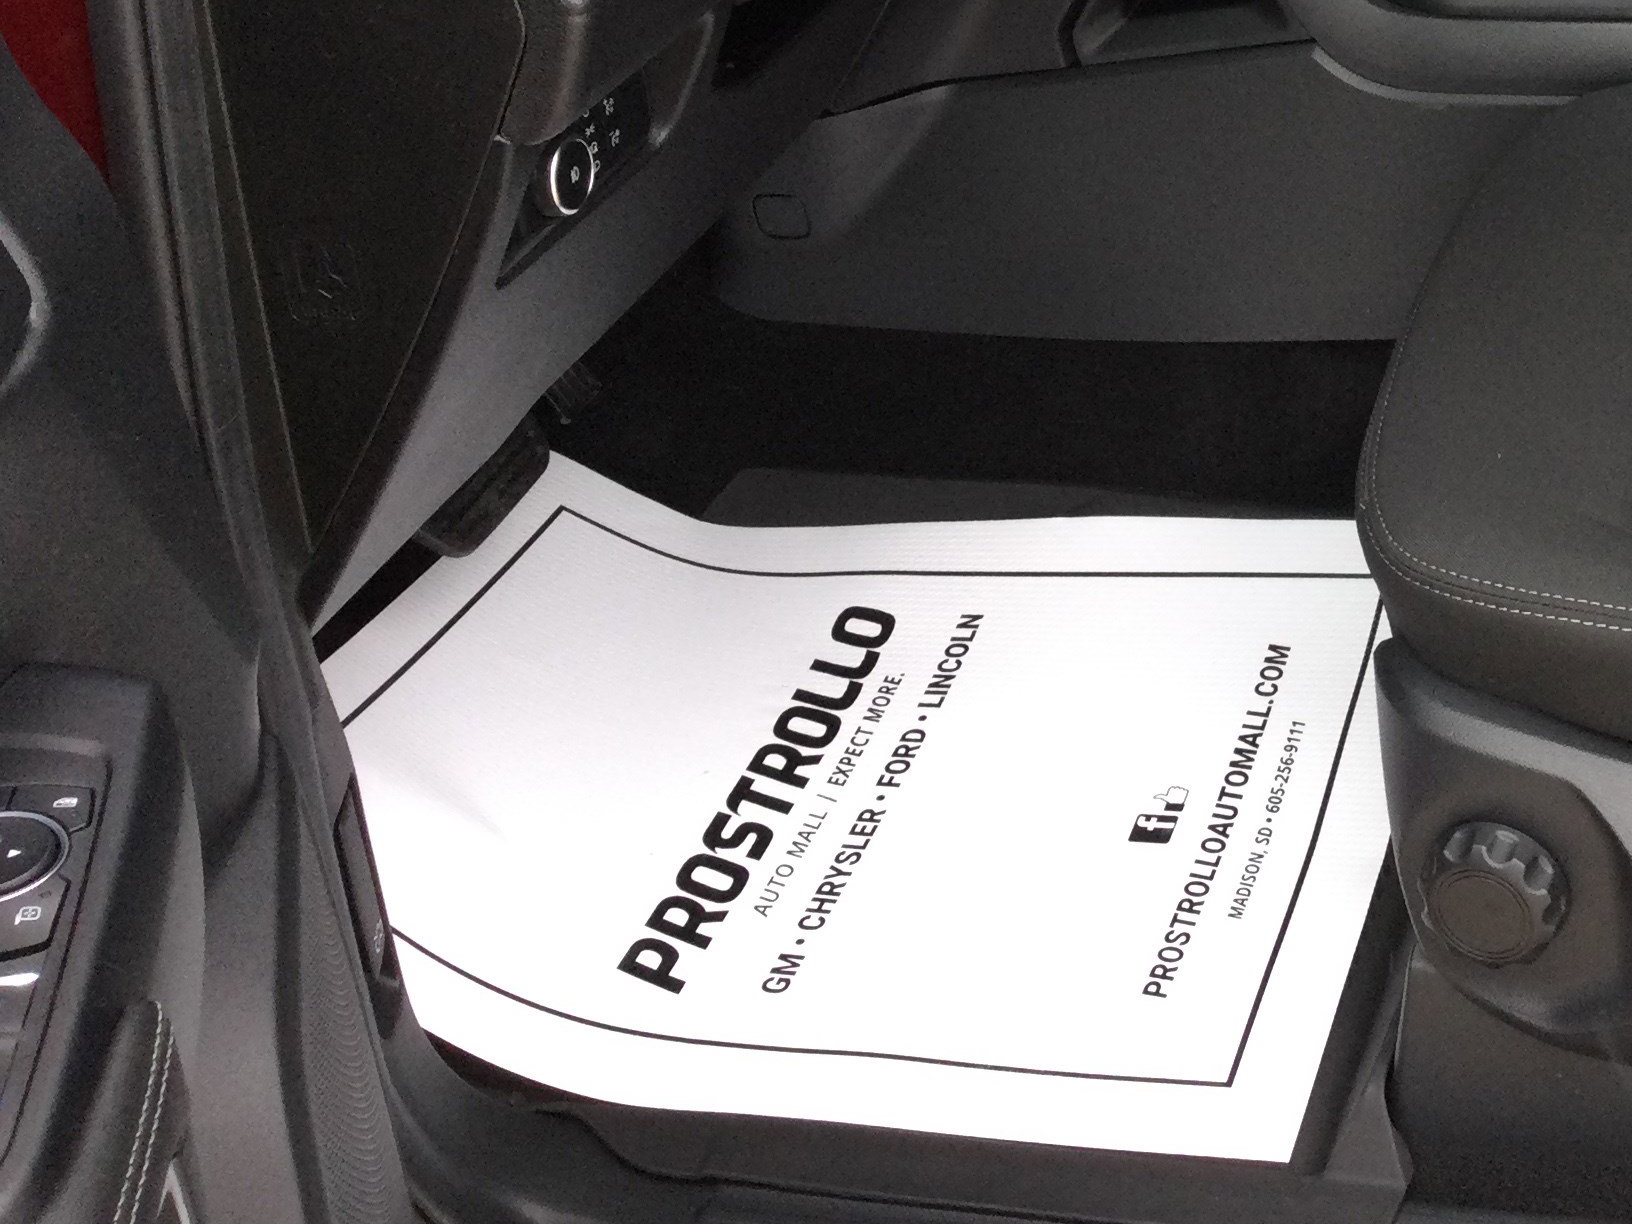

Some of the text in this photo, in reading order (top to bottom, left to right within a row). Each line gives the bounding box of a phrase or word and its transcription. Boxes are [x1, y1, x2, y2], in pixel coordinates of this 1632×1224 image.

[616, 605, 896, 995] PROSTROLLO
[753, 672, 906, 918] AUTO MALL EXPECT MORE.
[761, 613, 985, 994] GM CHRYSLER FORD LINCOLN
[1141, 643, 1292, 999] PROSTROLLOAUTOMALL.COM
[1227, 720, 1306, 920] MADISON, SD 605-256-9111
